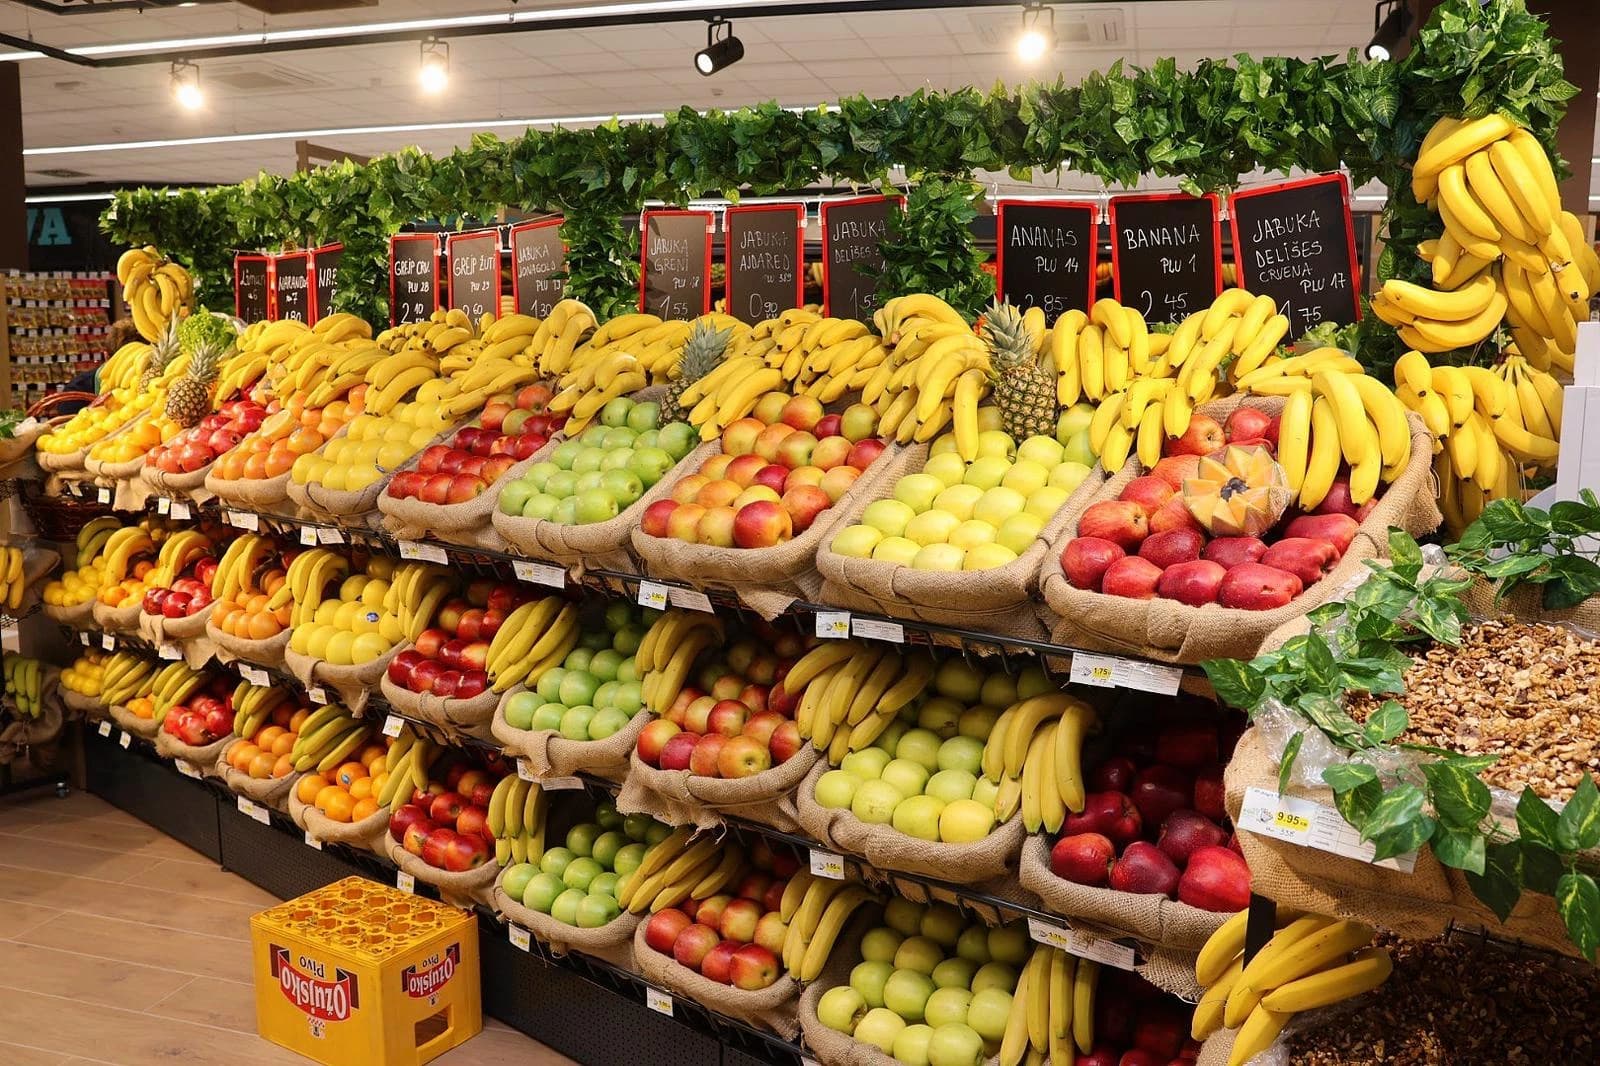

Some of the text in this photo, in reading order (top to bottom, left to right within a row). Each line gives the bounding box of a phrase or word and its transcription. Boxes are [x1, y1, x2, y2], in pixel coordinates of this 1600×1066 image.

[833, 220, 886, 241] JABUKA
[1011, 224, 1078, 249] ANANAS
[1123, 223, 1200, 250] BANANA
[1253, 210, 1320, 243] JABUKA
[651, 238, 689, 256] JABUKA
[741, 230, 789, 249] JABUKA
[517, 244, 549, 264] JABUKA
[1035, 255, 1079, 273] PLU 14
[1160, 253, 1196, 274] PLU 1
[1259, 262, 1313, 282] CRVENA
[407, 280, 430, 293] PLU 28
[535, 279, 548, 292] PLU
[1299, 273, 1346, 294] PLU 17
[473, 303, 483, 315] 60
[530, 299, 552, 318] 1 30
[660, 295, 689, 321] 1 55
[749, 293, 778, 318] 0 90
[849, 287, 858, 319] 1
[1044, 294, 1065, 312] 85
[1164, 292, 1188, 310] 45
[400, 302, 424, 324] 2 10
[1278, 299, 1321, 339] 1 75
[1277, 811, 1300, 826] 9.95
[409, 956, 454, 996] Ožujsko
[281, 966, 348, 1020] Ožujsko
